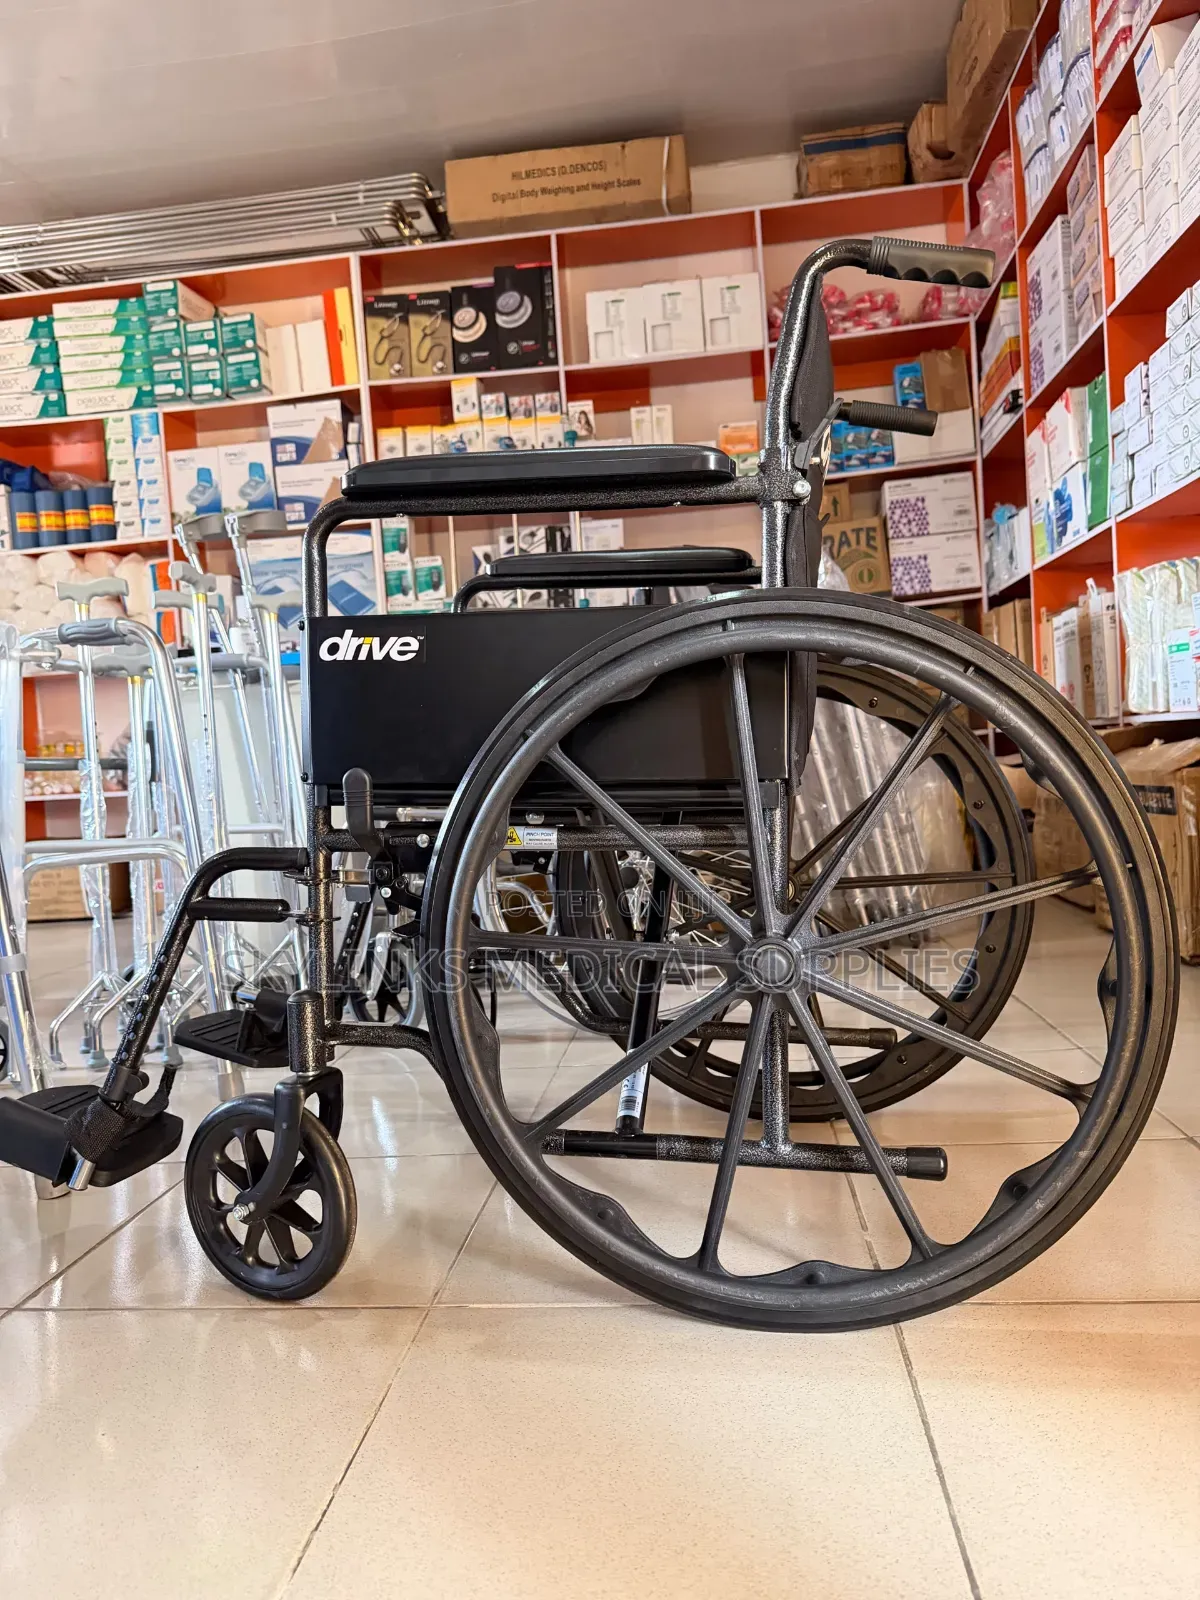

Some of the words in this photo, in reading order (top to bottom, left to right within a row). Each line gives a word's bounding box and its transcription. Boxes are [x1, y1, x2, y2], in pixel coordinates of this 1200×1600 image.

[511, 167, 557, 181] HILMEDICS
[492, 189, 519, 204] Digital
[520, 188, 539, 200] Body
[540, 184, 575, 197] Weighing
[576, 182, 590, 192] and
[591, 179, 616, 192] Height
[616, 177, 641, 188] Scales
[319, 629, 420, 661] drive
